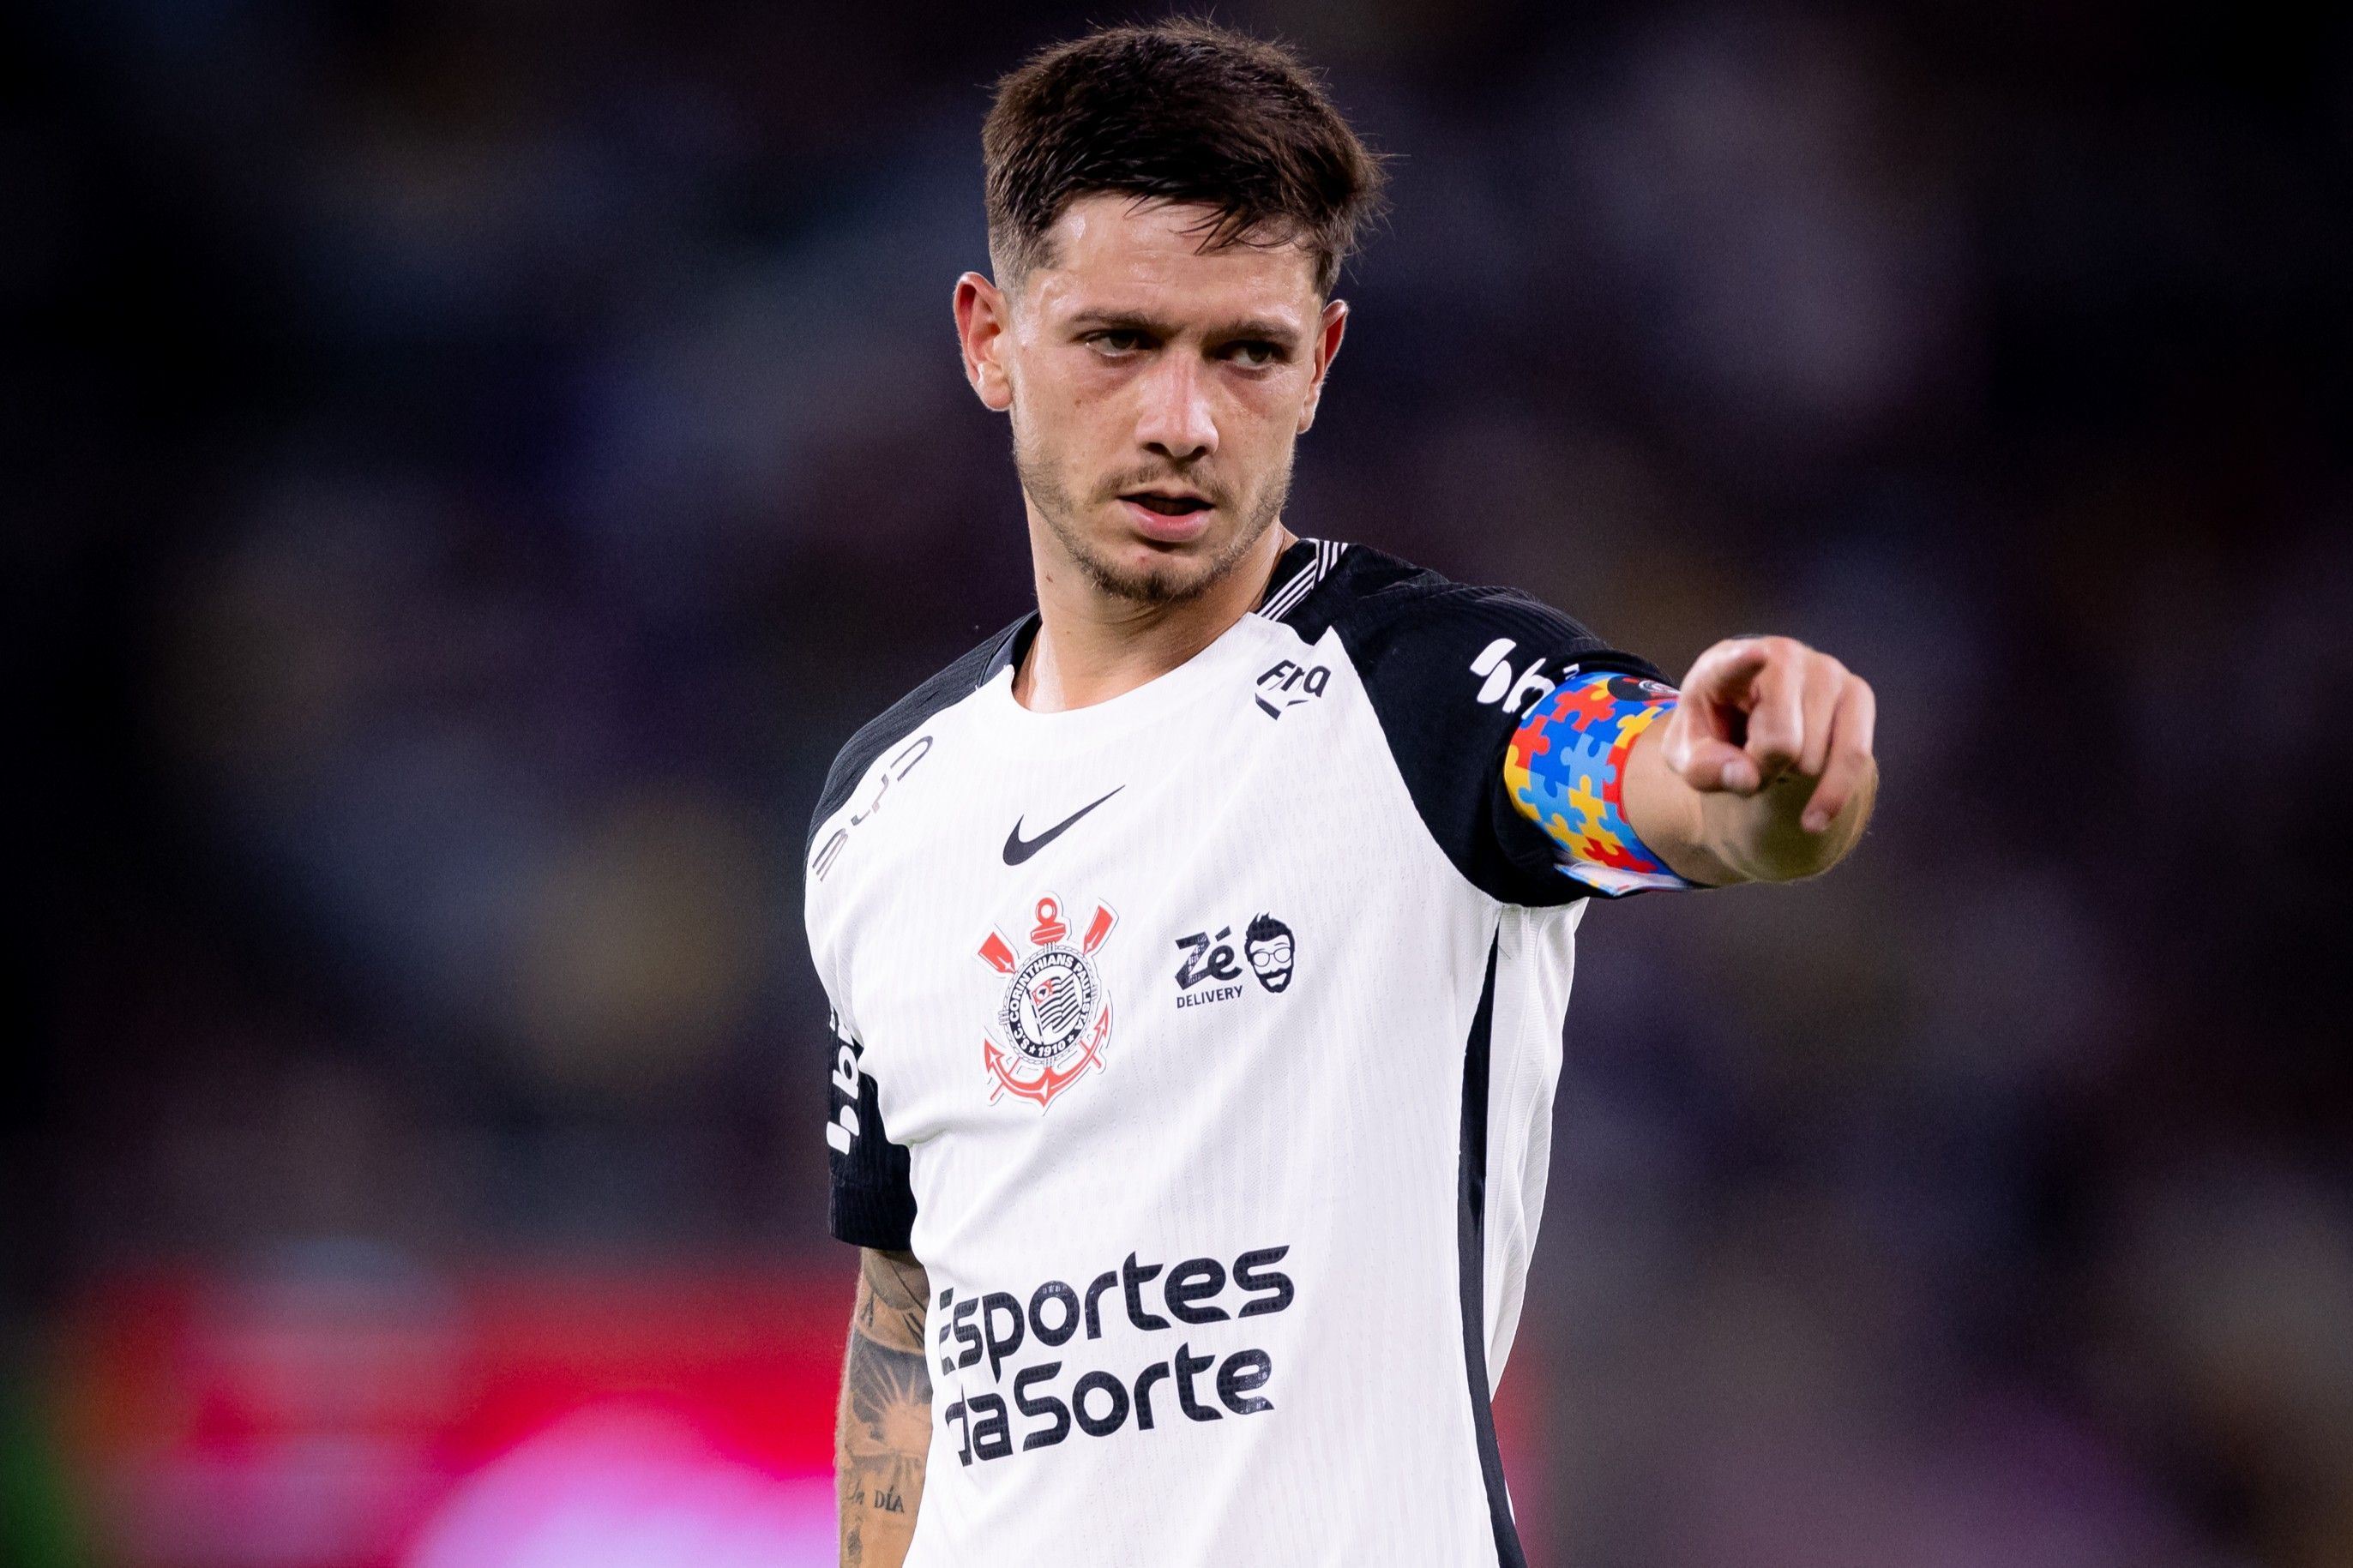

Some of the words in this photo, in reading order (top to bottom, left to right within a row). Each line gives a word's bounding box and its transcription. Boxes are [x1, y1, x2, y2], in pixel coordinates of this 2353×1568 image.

[1175, 926, 1243, 990] Zé
[1009, 953, 1074, 1022] CORINTHIANS
[1073, 962, 1091, 1030] PAULISTA
[1176, 985, 1243, 1008] DELIVERY
[1038, 1041, 1067, 1057] 1910
